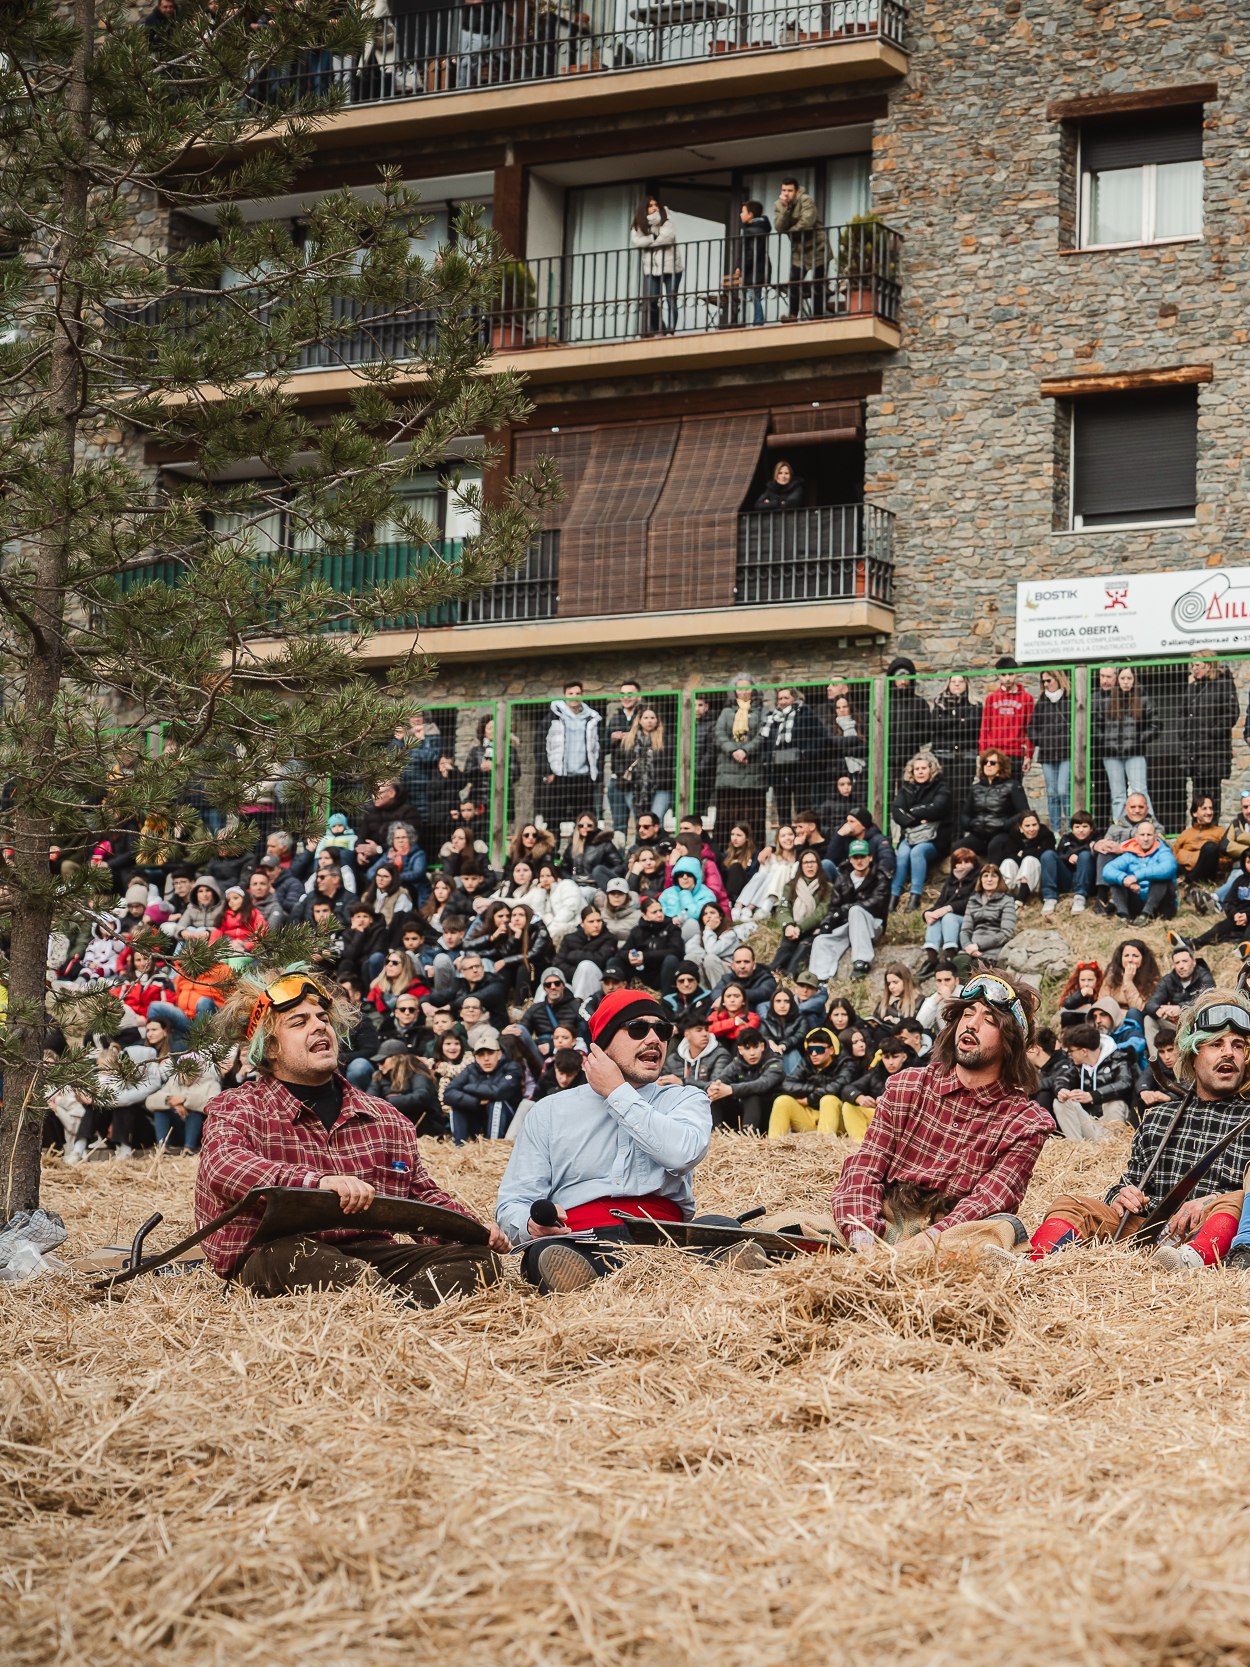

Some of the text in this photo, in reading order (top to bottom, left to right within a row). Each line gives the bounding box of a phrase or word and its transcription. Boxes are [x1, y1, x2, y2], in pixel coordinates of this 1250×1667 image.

[1035, 589, 1078, 601] BOSTIK
[1038, 625, 1119, 638] BOTIGA OBERTA
